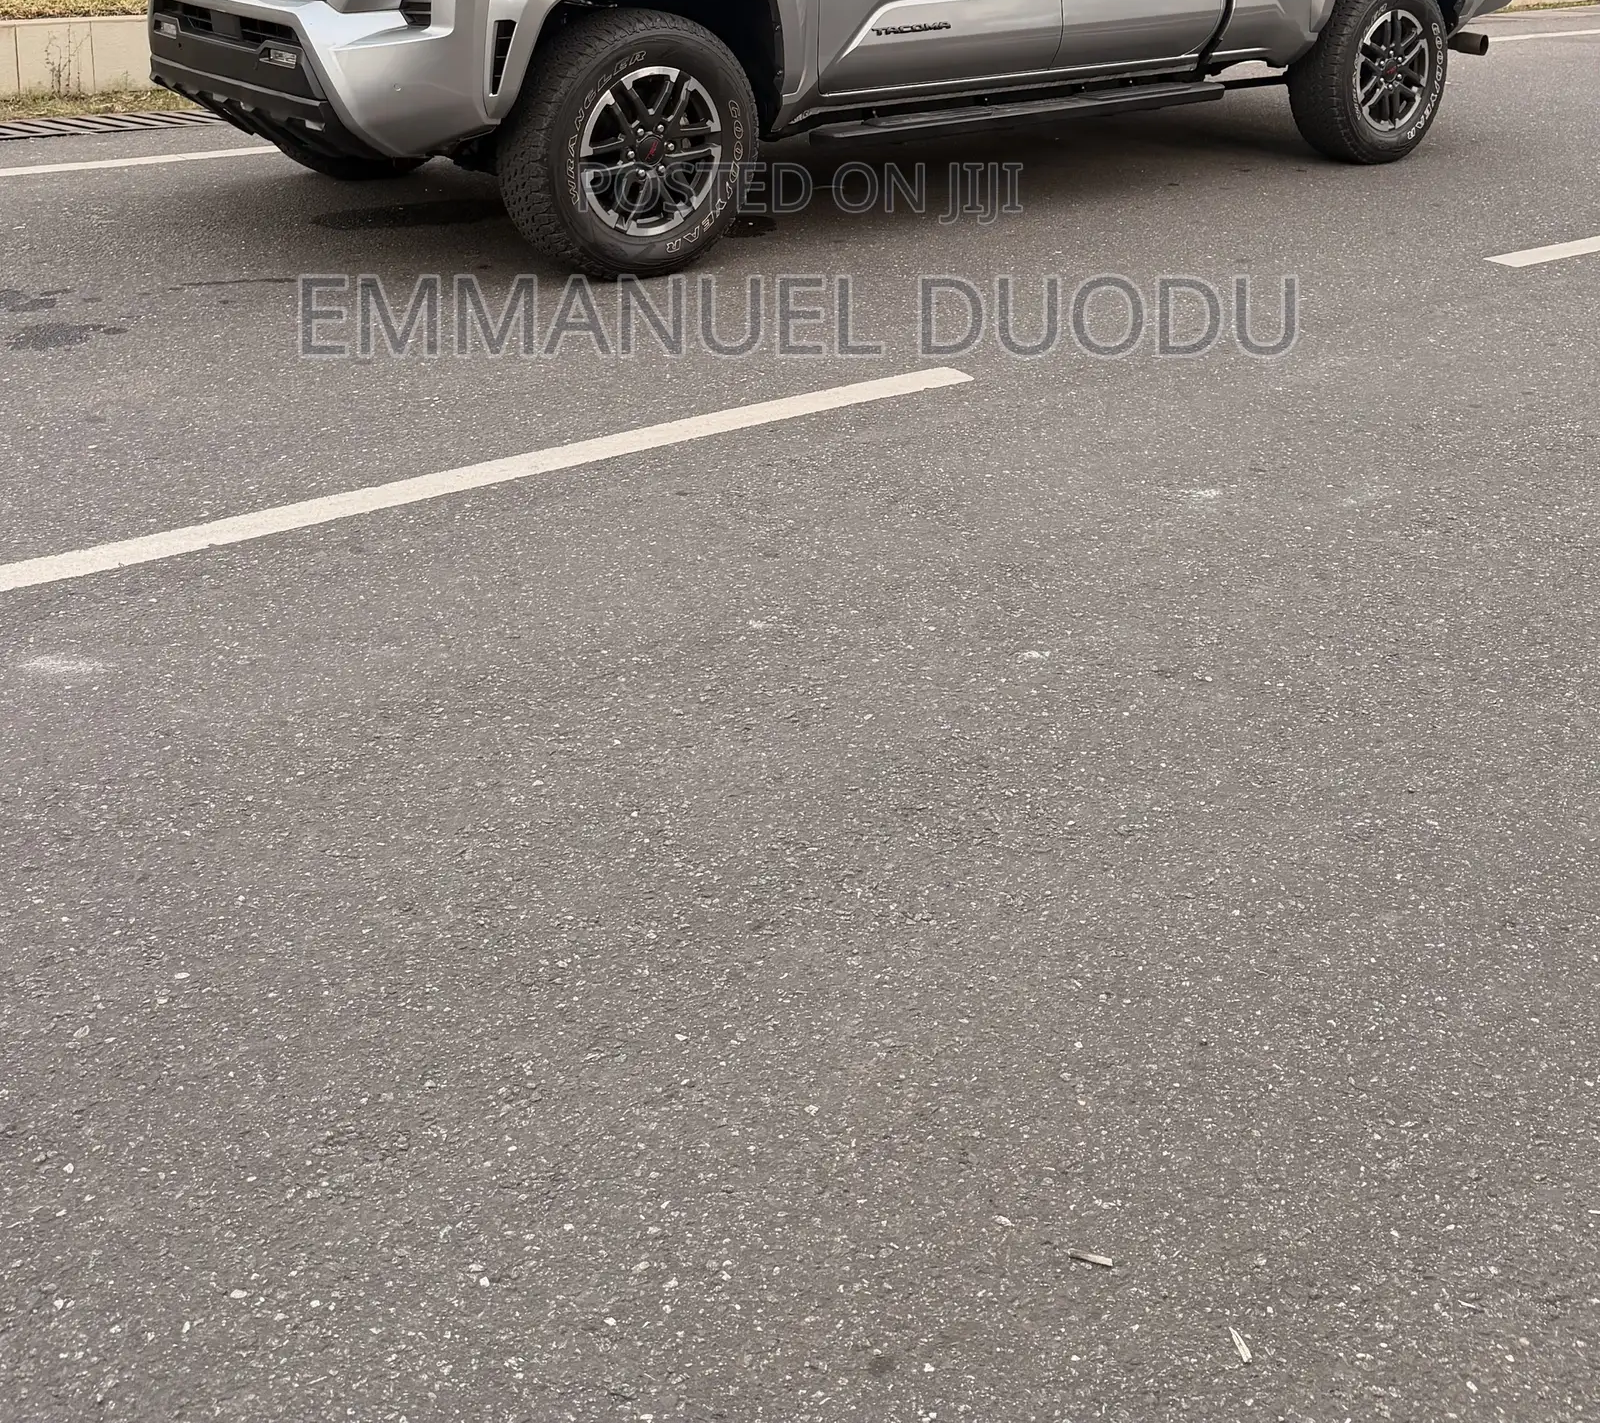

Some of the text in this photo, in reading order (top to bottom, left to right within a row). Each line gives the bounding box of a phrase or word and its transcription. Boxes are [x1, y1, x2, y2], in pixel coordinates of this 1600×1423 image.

[871, 21, 952, 36] TACOMA
[1407, 22, 1444, 140] GOODYEAR
[566, 51, 646, 205] WRANGLER
[666, 99, 744, 254] GOODYEAR
